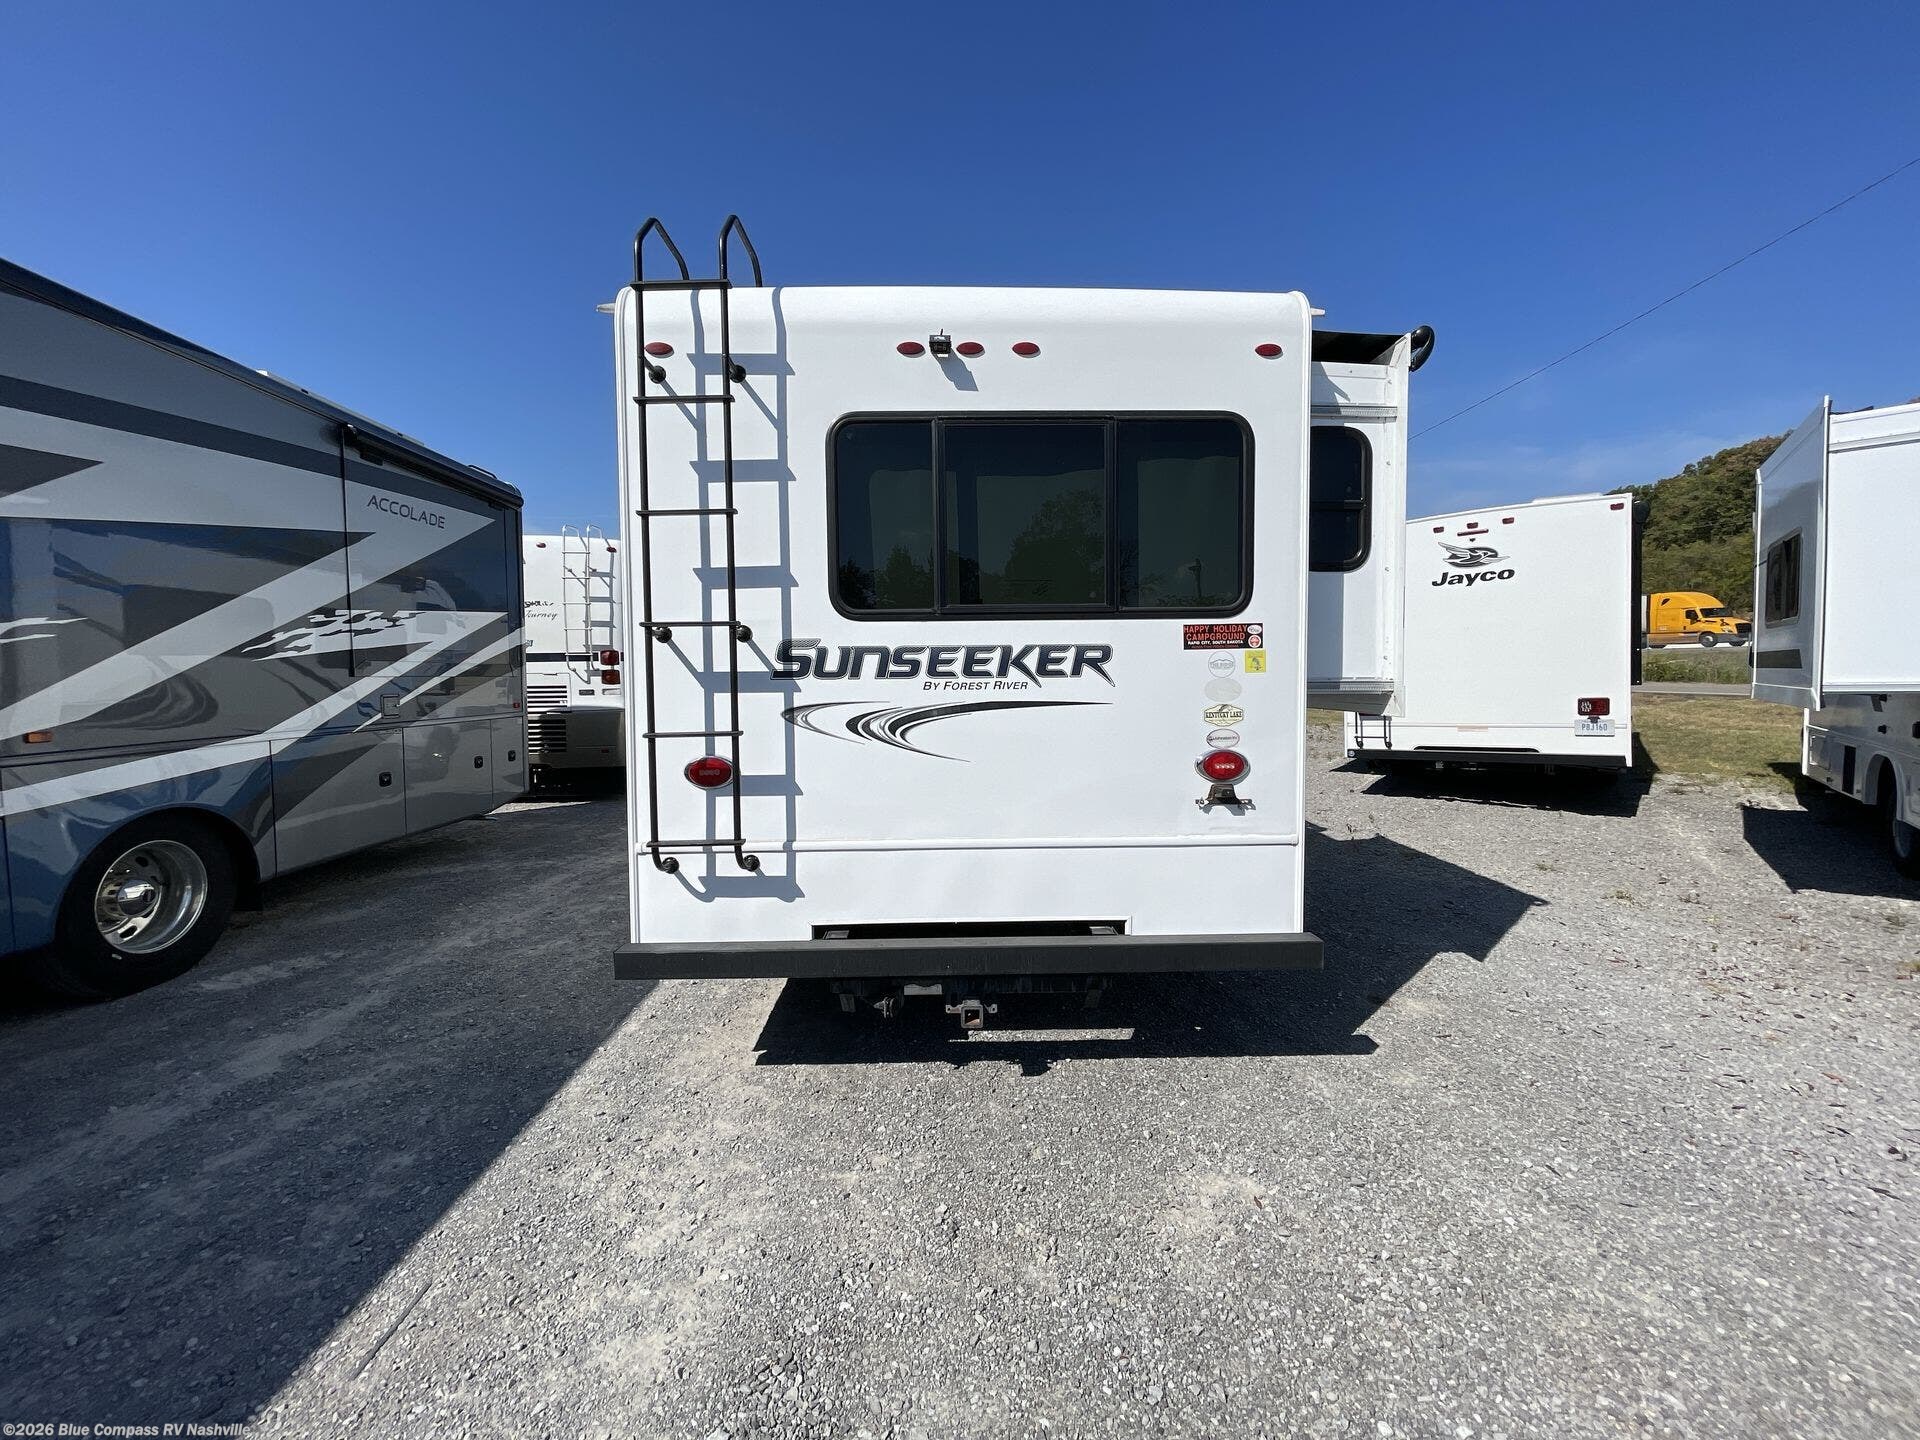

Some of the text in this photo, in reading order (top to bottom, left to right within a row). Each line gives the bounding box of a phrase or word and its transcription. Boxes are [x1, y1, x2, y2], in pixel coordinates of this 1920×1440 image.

[366, 494, 446, 529] ACCOLADE
[1431, 569, 1516, 587] Jayco
[1184, 625, 1209, 633] HAPPY
[1213, 624, 1248, 633] HOLIDAY
[1186, 632, 1246, 641] CAMPGROUND
[769, 638, 1116, 688] SUNSEEKER
[922, 680, 1029, 691] BY FOREST RIVER
